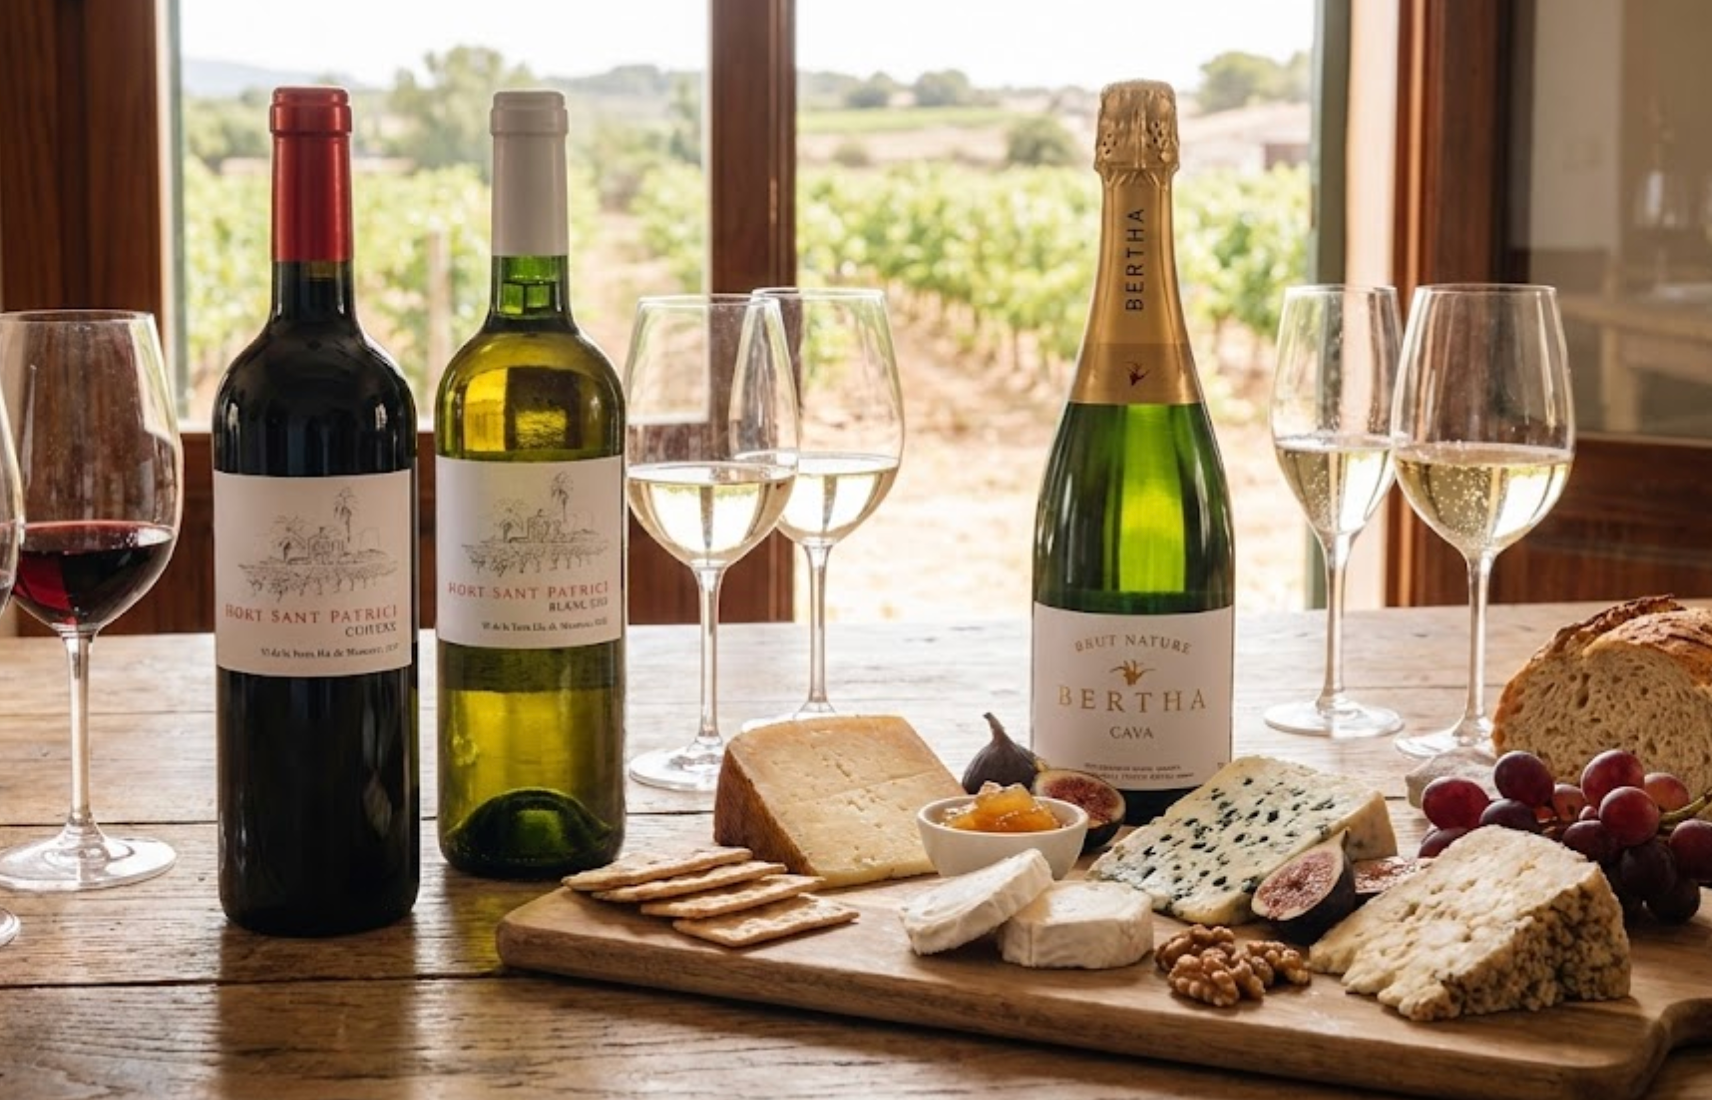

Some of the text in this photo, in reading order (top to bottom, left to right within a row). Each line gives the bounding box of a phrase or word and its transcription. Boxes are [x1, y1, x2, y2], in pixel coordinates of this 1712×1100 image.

[1125, 208, 1145, 311] BERTHA
[449, 580, 608, 600] HORT SANT PATRICI
[271, 609, 320, 624] SANT
[330, 604, 397, 624] PATRICI
[1075, 634, 1192, 654] BRUT NATURE
[1058, 685, 1207, 713] BERTHA
[1109, 725, 1154, 740] CAVA
